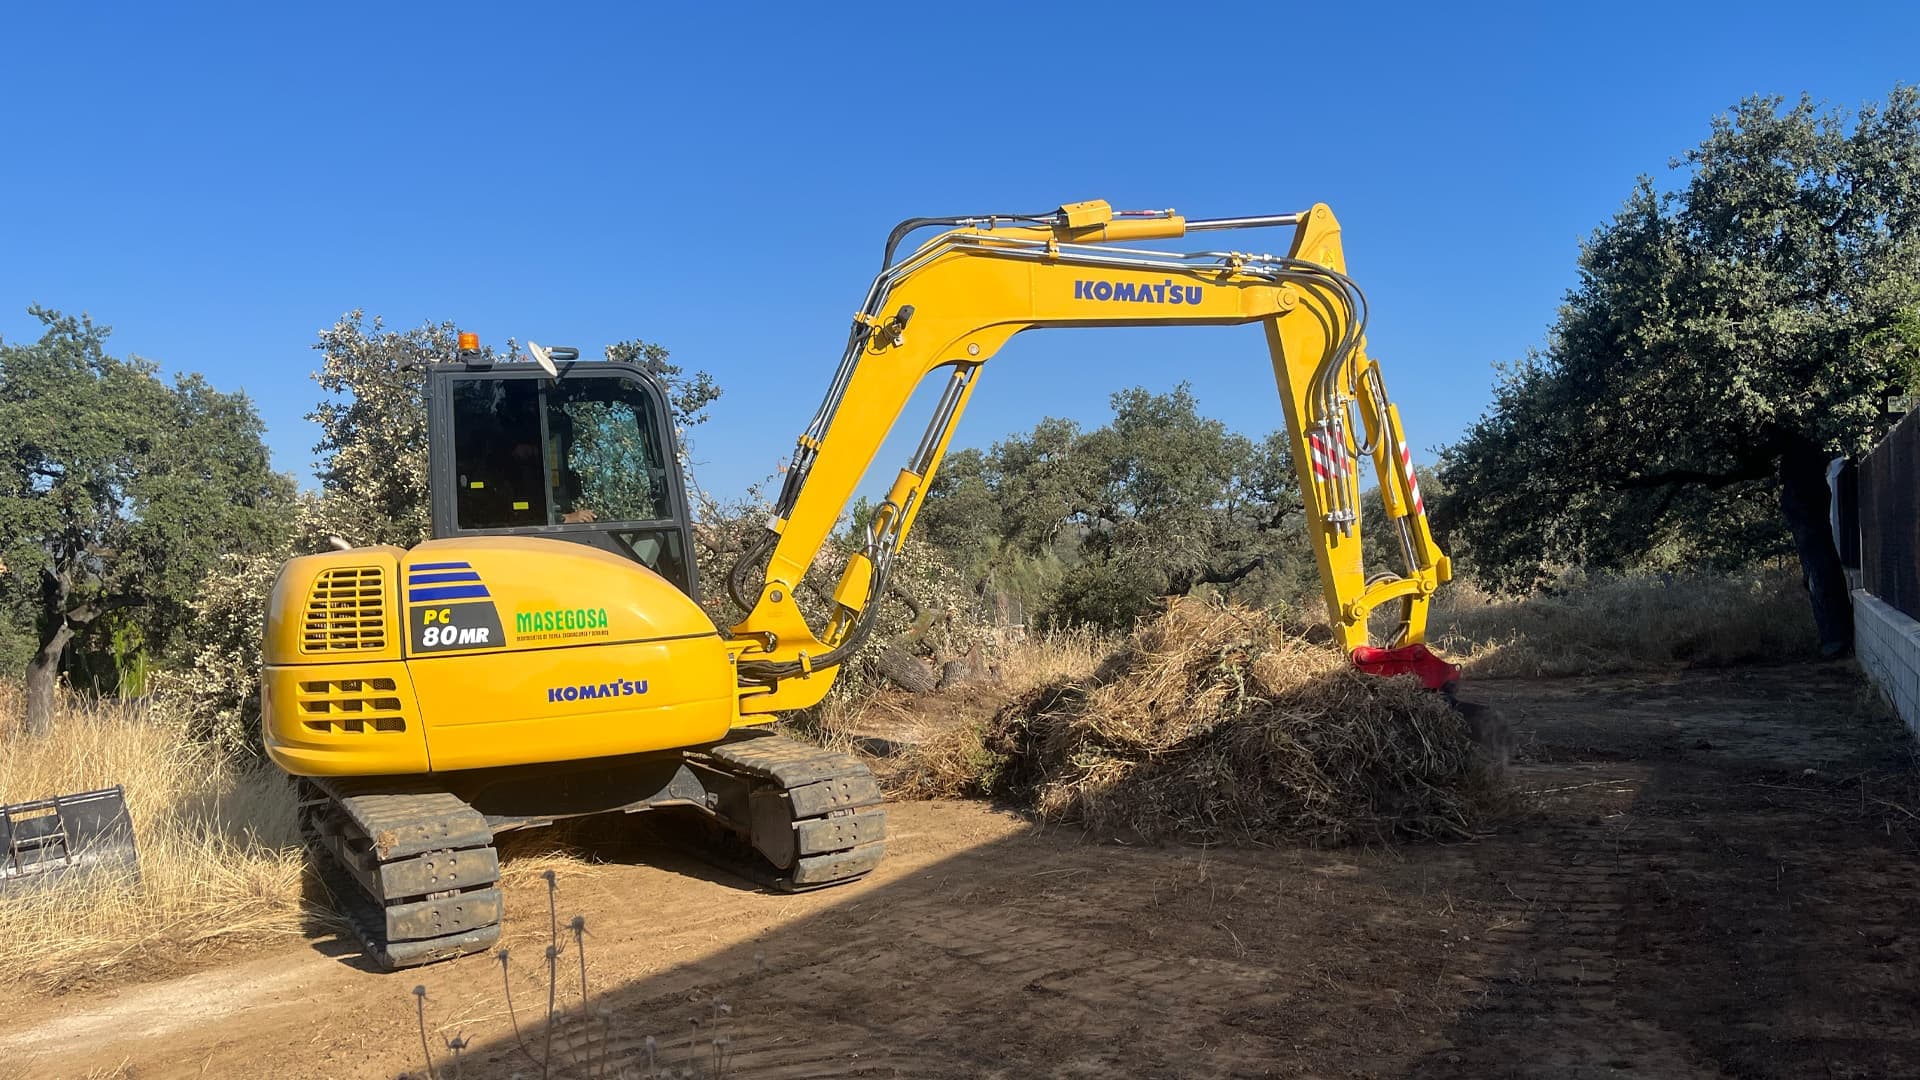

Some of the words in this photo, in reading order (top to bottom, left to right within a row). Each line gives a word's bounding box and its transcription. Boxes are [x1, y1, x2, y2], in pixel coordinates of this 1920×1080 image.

[1075, 279, 1202, 304] KOMATSU
[423, 608, 451, 625] PC
[516, 608, 608, 632] MASEGOSA
[549, 679, 647, 702] KOMATSU
